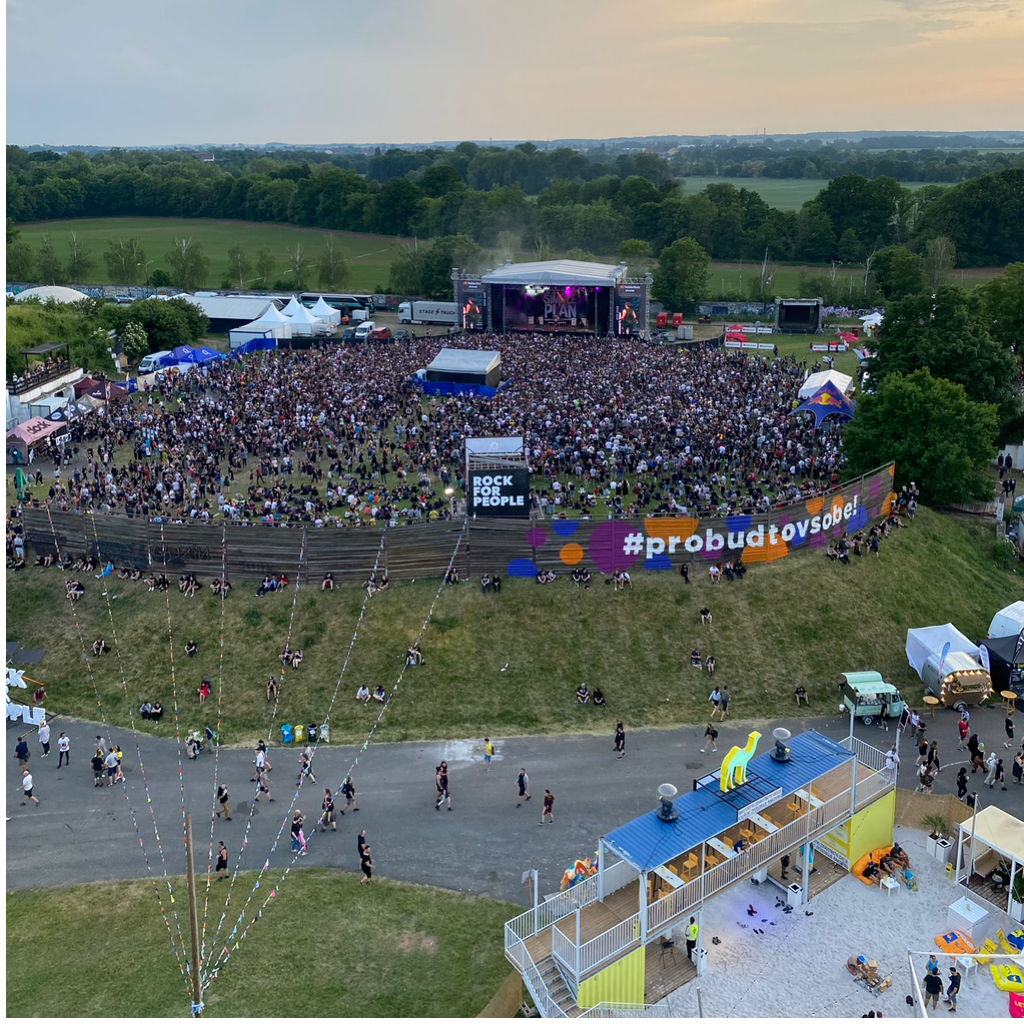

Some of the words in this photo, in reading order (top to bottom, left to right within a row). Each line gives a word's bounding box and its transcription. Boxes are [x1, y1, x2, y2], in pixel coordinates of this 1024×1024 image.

[473, 475, 513, 487] ROCK
[473, 486, 501, 496] FOR
[473, 495, 525, 507] PEOPLE
